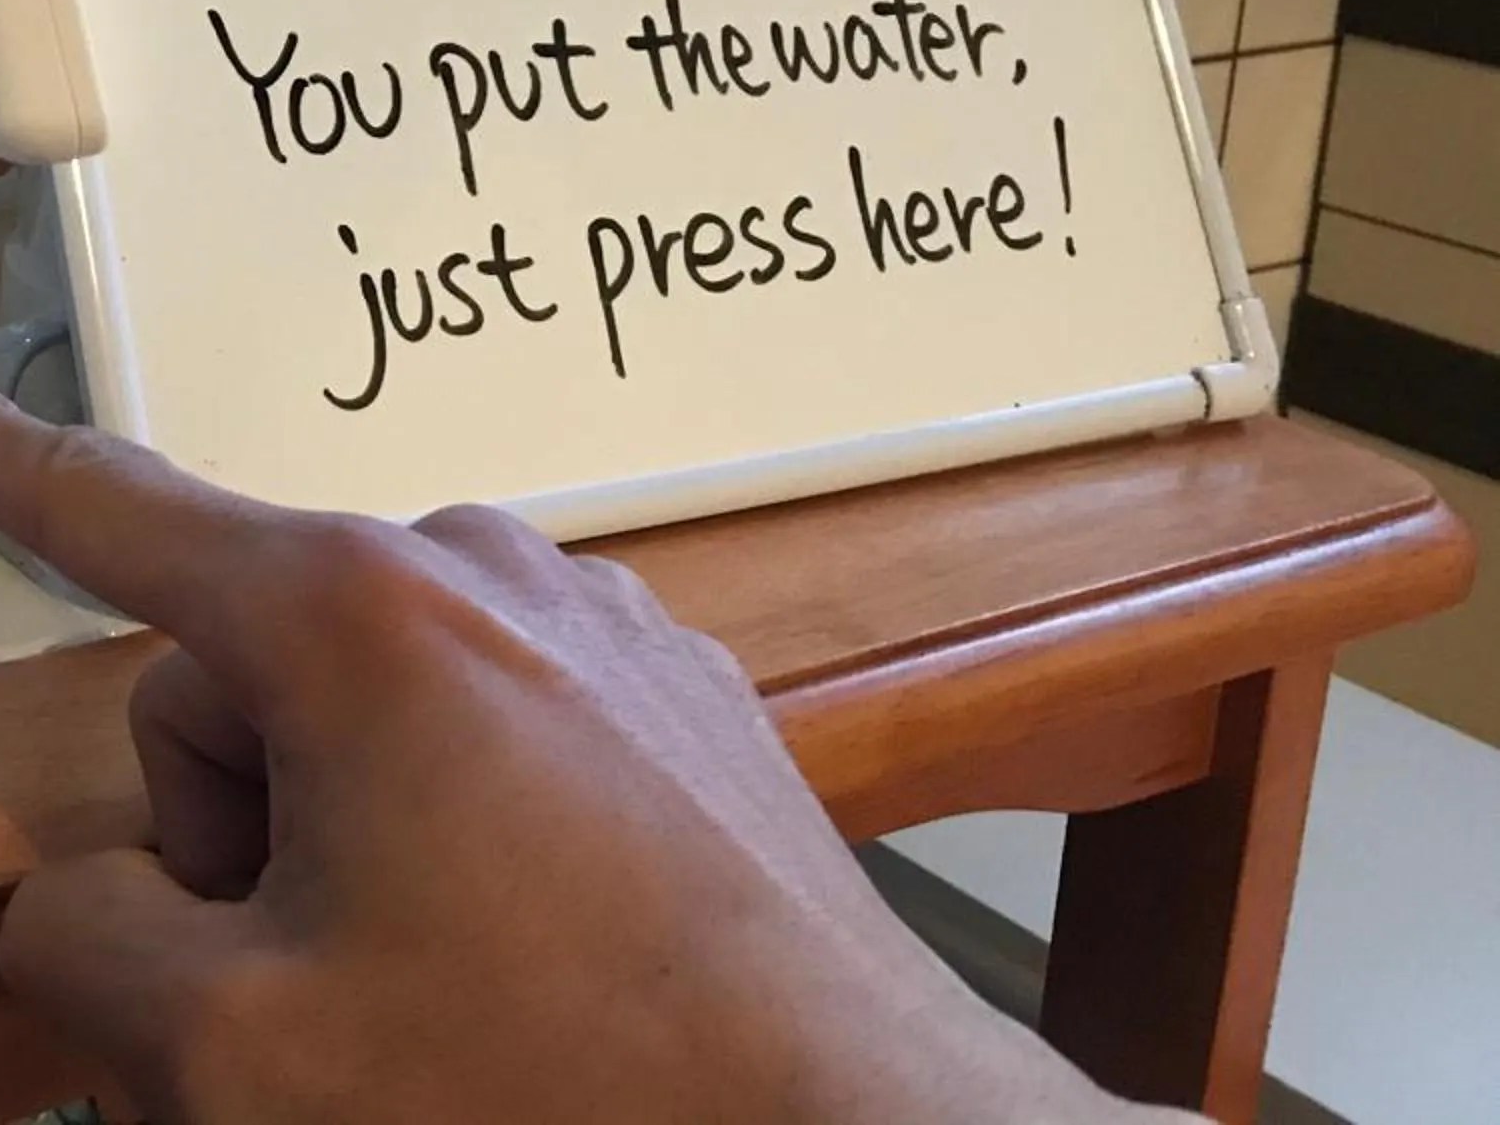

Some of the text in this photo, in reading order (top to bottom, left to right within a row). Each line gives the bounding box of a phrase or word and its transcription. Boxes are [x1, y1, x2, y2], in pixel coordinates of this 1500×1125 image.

[206, 8, 404, 165] You
[428, 17, 610, 197] put
[322, 115, 1077, 412] just press here!
